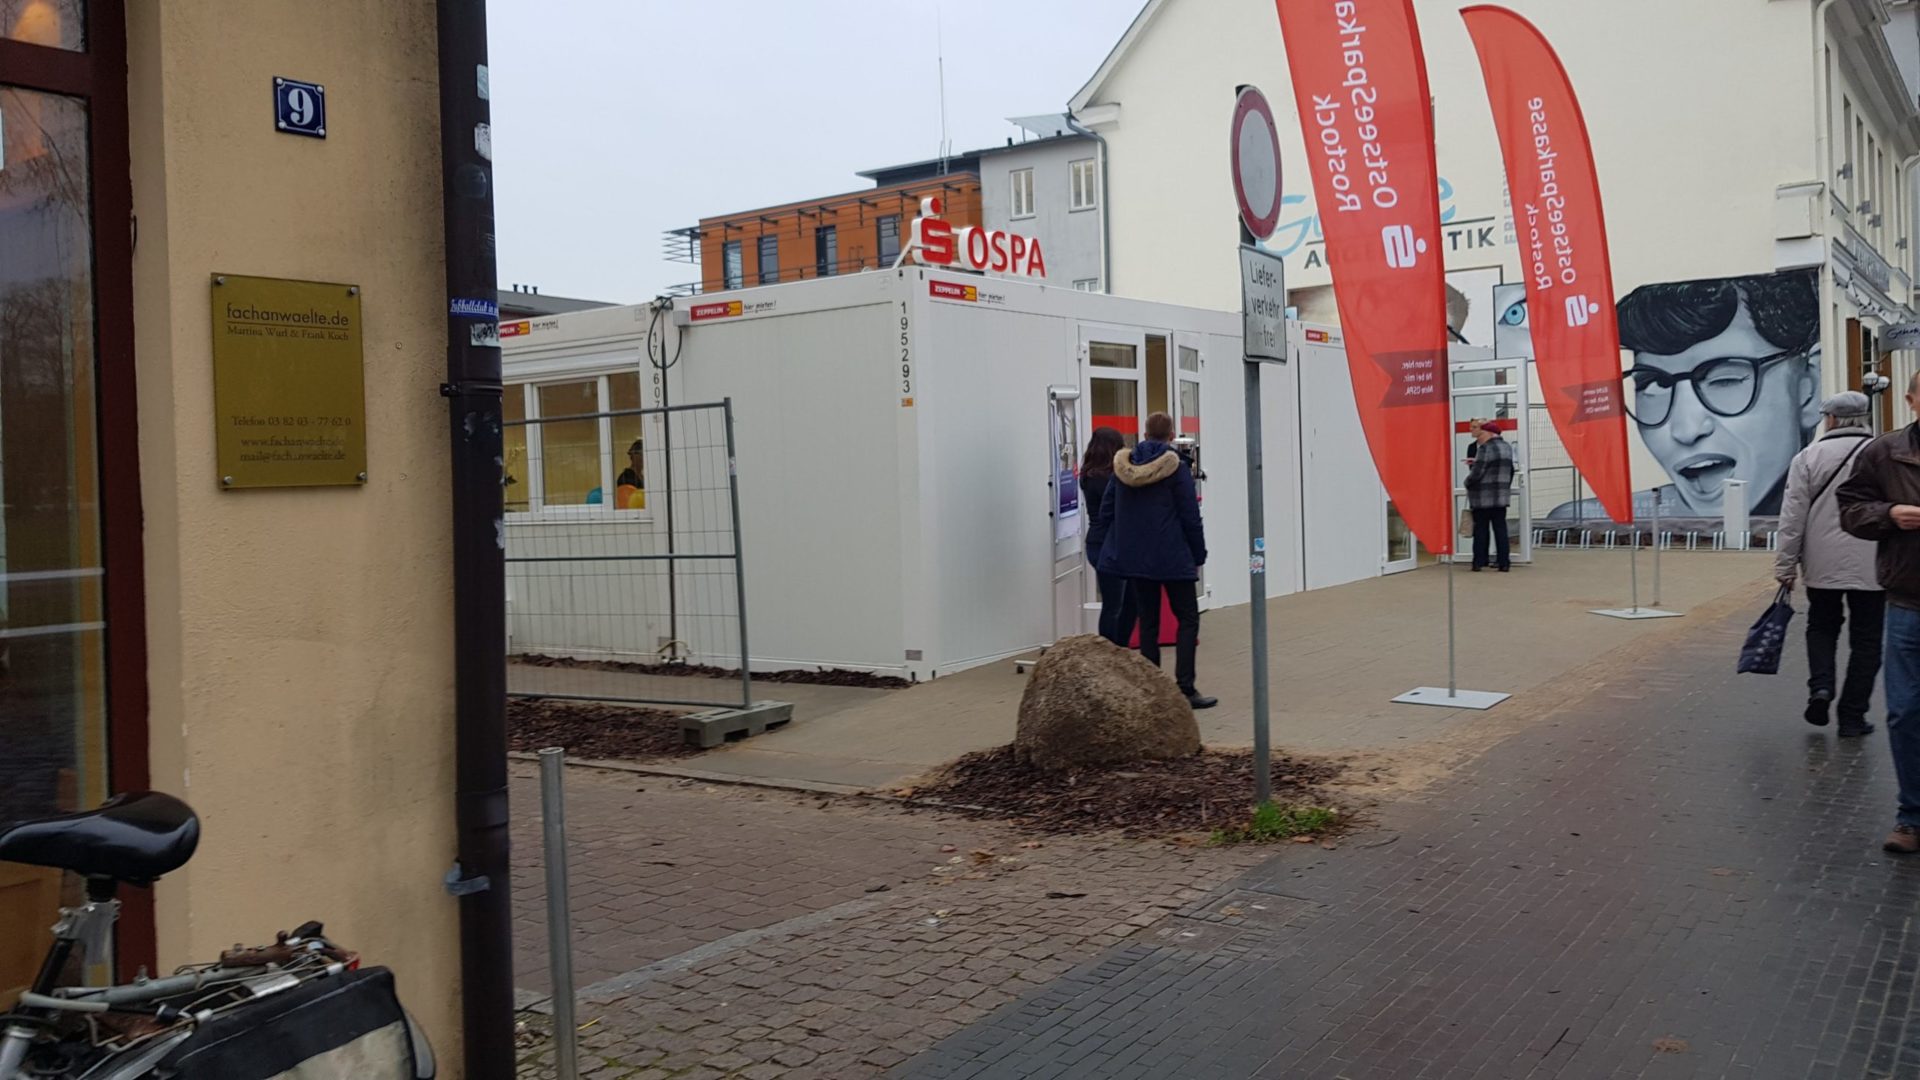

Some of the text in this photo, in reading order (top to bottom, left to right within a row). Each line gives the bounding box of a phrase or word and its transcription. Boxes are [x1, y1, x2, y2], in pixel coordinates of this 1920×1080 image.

[288, 88, 314, 126] 9
[967, 225, 1046, 278] OSPA
[1249, 260, 1277, 288] Liefer-
[934, 285, 961, 296] ZEPPELIN
[226, 302, 349, 326] fachanwaelte.de
[695, 306, 724, 317] ZEPPELIN
[1251, 295, 1280, 320] verkehr
[227, 325, 263, 336] Martina
[289, 329, 299, 338] &
[301, 329, 325, 340] Frank
[327, 331, 349, 341] Koch
[1263, 324, 1276, 348] frei
[900, 301, 911, 394] 195293
[232, 416, 266, 427] Telefon
[268, 416, 280, 427] 03
[282, 416, 295, 427] 82
[297, 416, 309, 427] 03
[317, 416, 329, 427] 77
[331, 416, 343, 427] 62
[344, 416, 352, 427] 0
